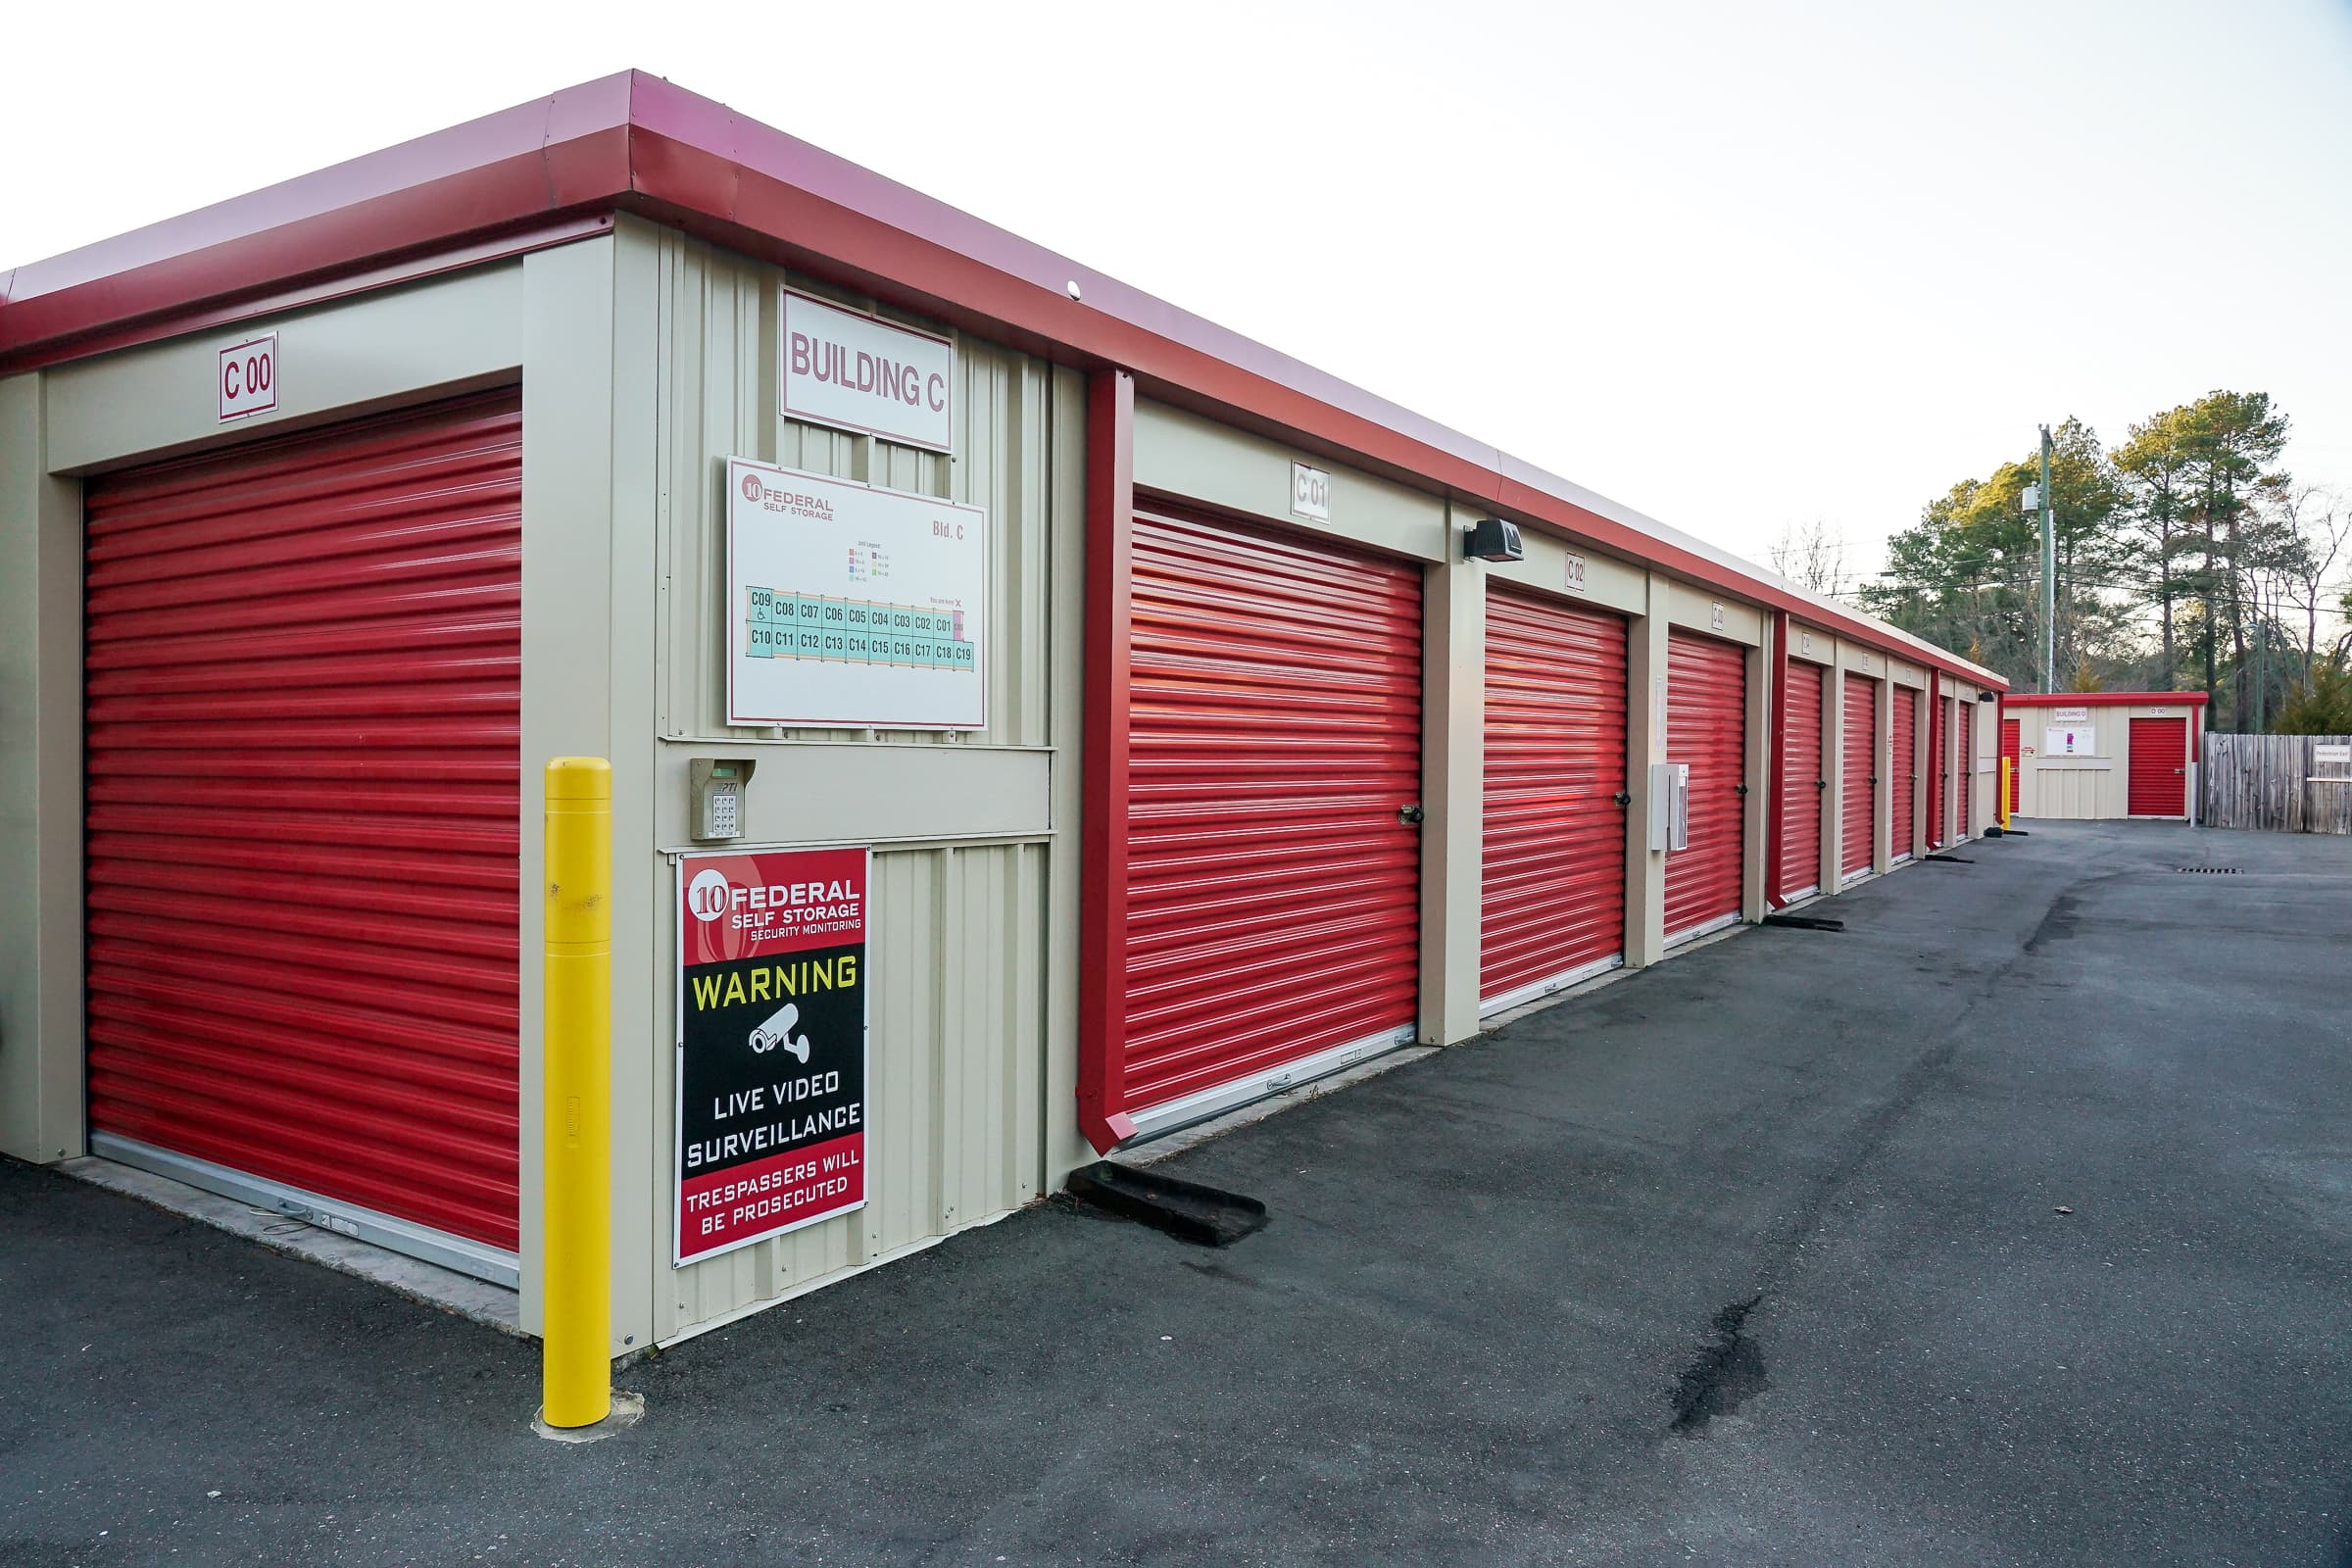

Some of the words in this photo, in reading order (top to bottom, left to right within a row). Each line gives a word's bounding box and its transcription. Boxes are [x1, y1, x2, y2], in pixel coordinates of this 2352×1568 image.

[224, 361, 240, 400] C
[246, 353, 270, 394] 00
[791, 331, 920, 406] BUILDING
[927, 373, 945, 412] C
[744, 480, 762, 501] 10
[763, 488, 833, 513] FEDERAL
[1297, 473, 1307, 502] C
[1311, 478, 1326, 508] 01
[763, 502, 787, 513] SELF
[791, 507, 833, 521] STORAGE
[933, 519, 953, 538] Bld.
[956, 524, 963, 540] C
[1568, 560, 1574, 579] C
[1575, 563, 1584, 582] 02
[752, 592, 771, 607] C09
[775, 602, 794, 616] C08
[801, 605, 819, 618] C07
[825, 607, 843, 620] C06
[849, 610, 866, 623] C05
[872, 612, 888, 625] C04
[894, 613, 910, 628] C03
[915, 616, 931, 630] C02
[936, 618, 951, 632] C01
[752, 629, 771, 644] C10
[775, 631, 793, 646] C11
[801, 633, 819, 648] C12
[825, 636, 843, 650] C13
[849, 638, 866, 652] C14
[872, 640, 889, 654] C15
[894, 642, 910, 656] C16
[915, 644, 931, 657] C17
[936, 646, 952, 659] C18
[956, 647, 971, 661] C19
[721, 782, 738, 793] PTI
[694, 882, 729, 917] 10
[731, 879, 860, 911] FEDERAL
[731, 911, 775, 930] SELF
[782, 903, 859, 924] STORAGE
[751, 926, 800, 942] SECURITY
[803, 918, 861, 935] MONITORING
[692, 956, 857, 1011] WARNING
[714, 1087, 764, 1120] LIVE
[773, 1070, 839, 1104] VIDEO
[687, 1102, 860, 1168] SURVEILLANCE
[686, 1161, 816, 1213] TRESPASSERS
[822, 1149, 859, 1173] WILL
[702, 1212, 725, 1236] BE
[733, 1176, 848, 1226] PROSECUTED
